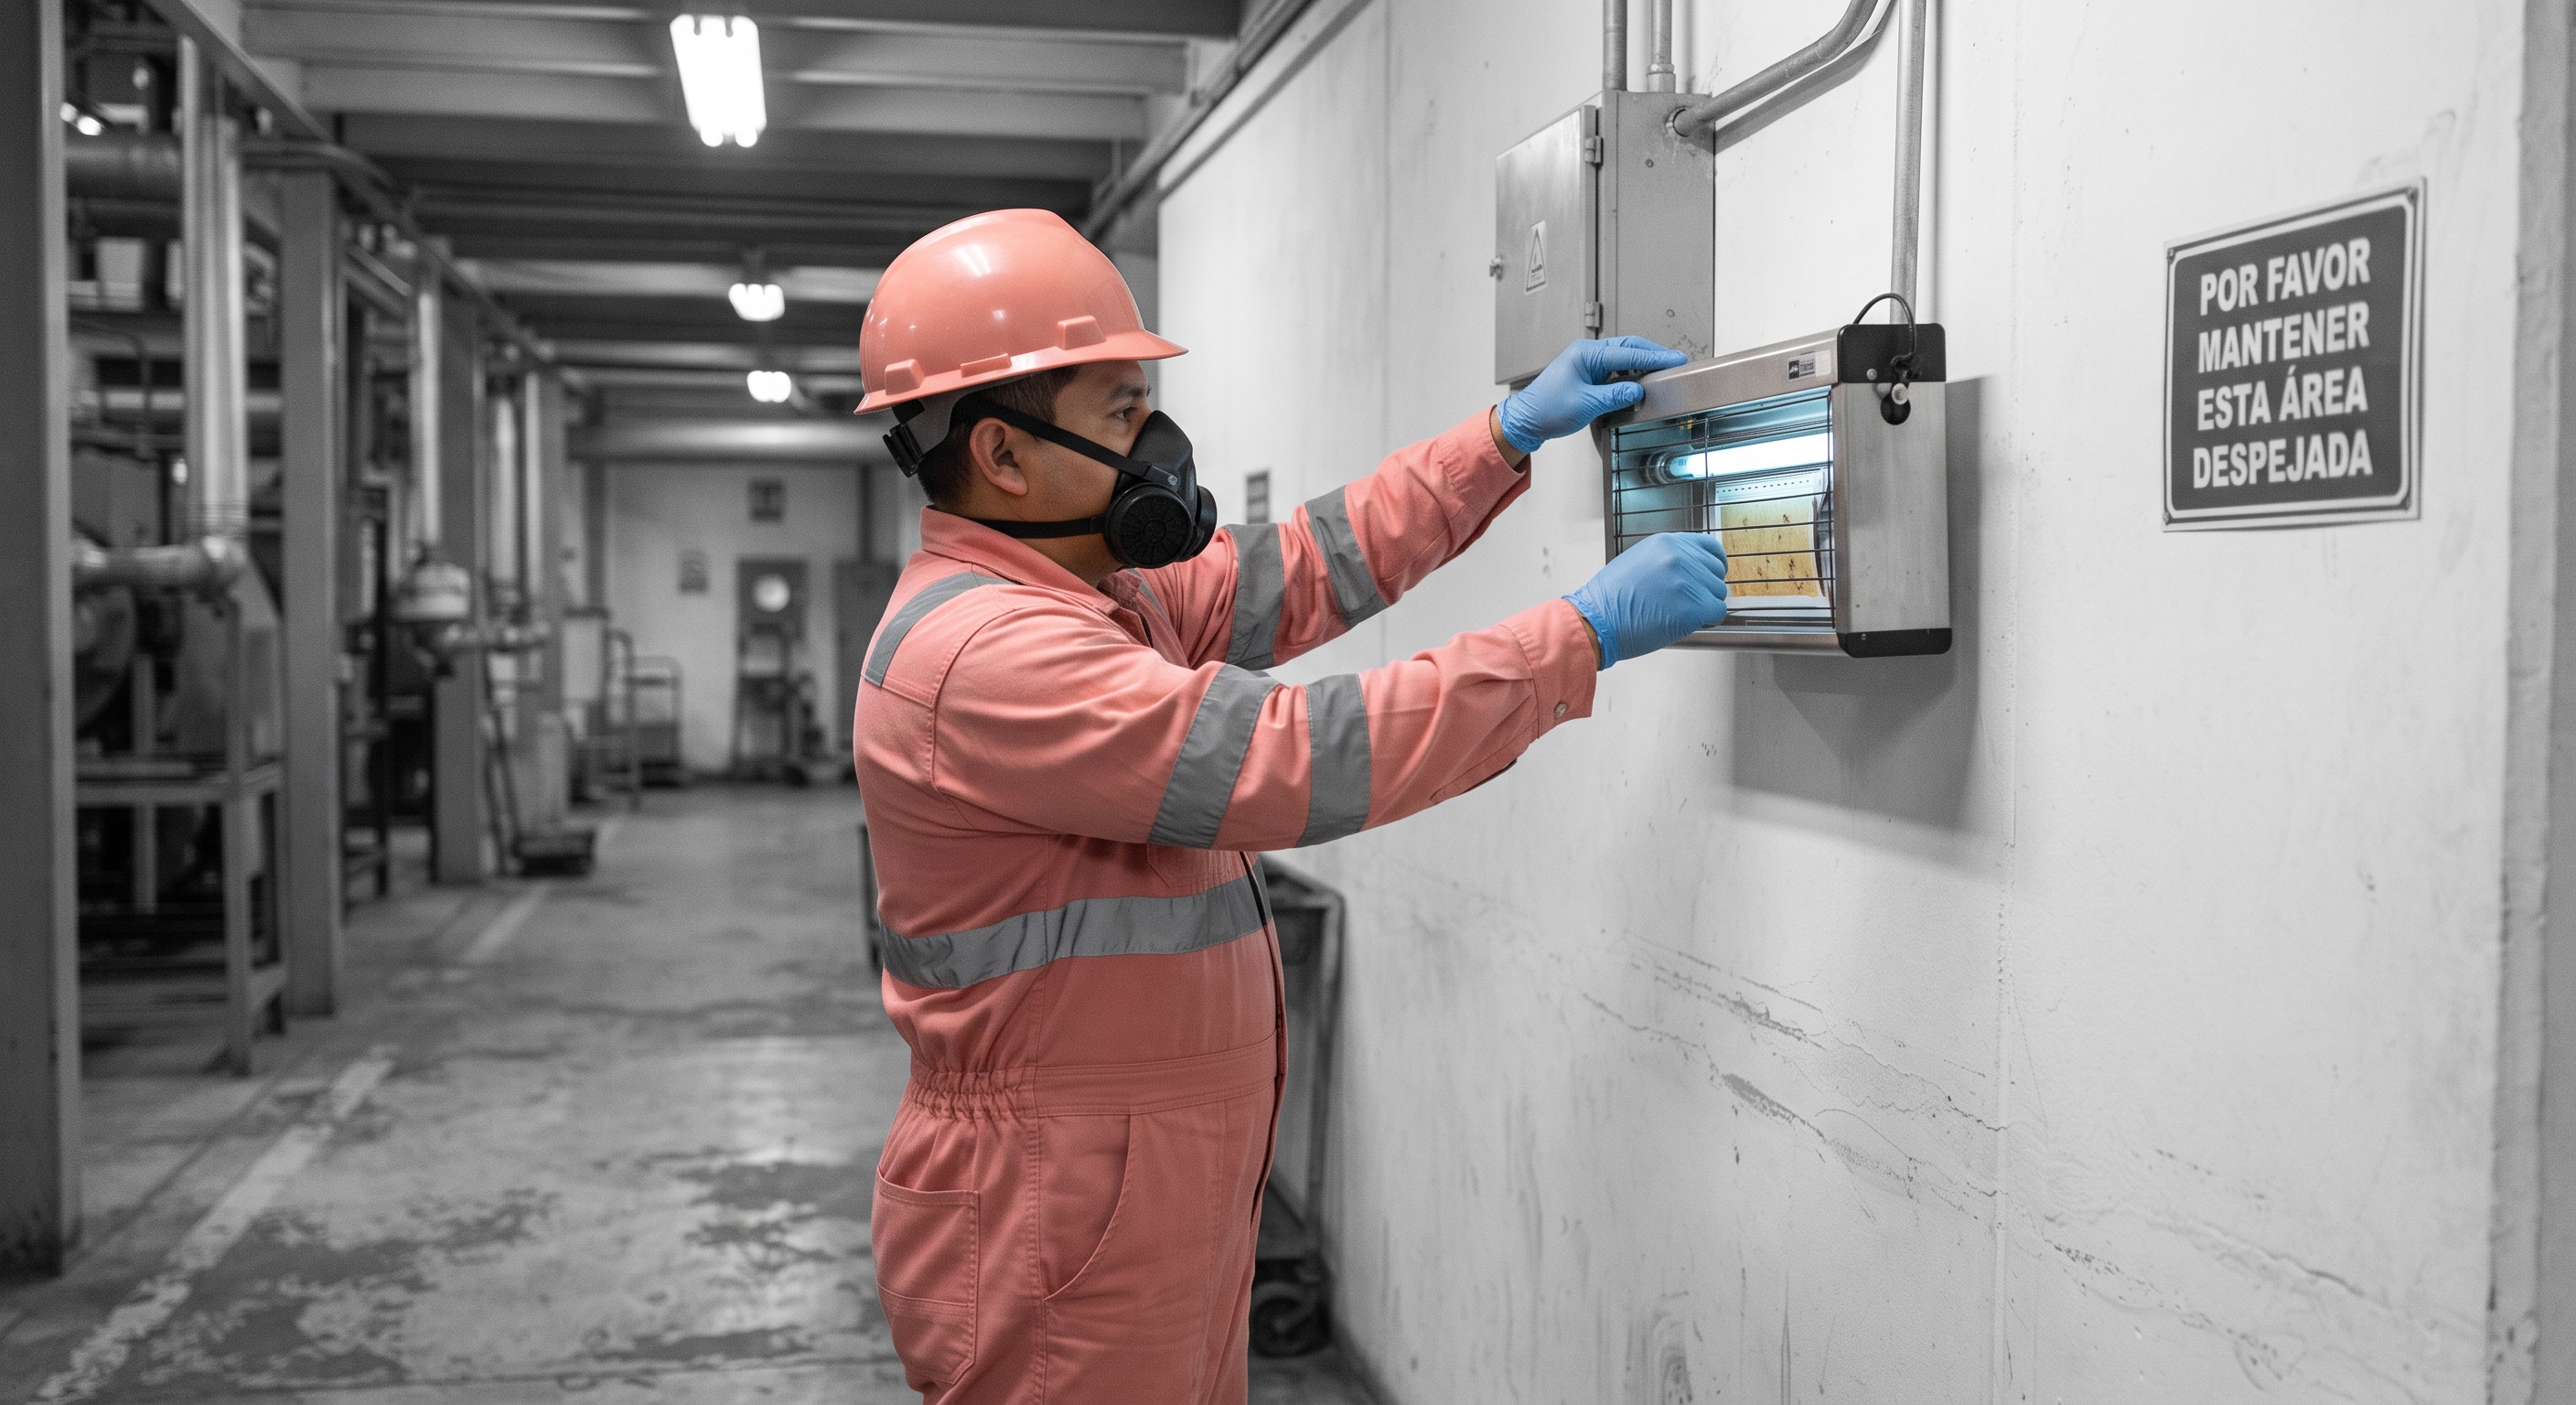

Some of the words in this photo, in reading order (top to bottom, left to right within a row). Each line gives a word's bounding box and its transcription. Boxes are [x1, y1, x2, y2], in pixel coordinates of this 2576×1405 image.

[2199, 263, 2259, 316] POR
[2267, 237, 2371, 303] FAVOR
[2198, 301, 2370, 373] MANTENER
[2197, 381, 2271, 431] ESTA
[2279, 365, 2368, 421] ÁREA
[2194, 429, 2373, 488] DESPEJADA
